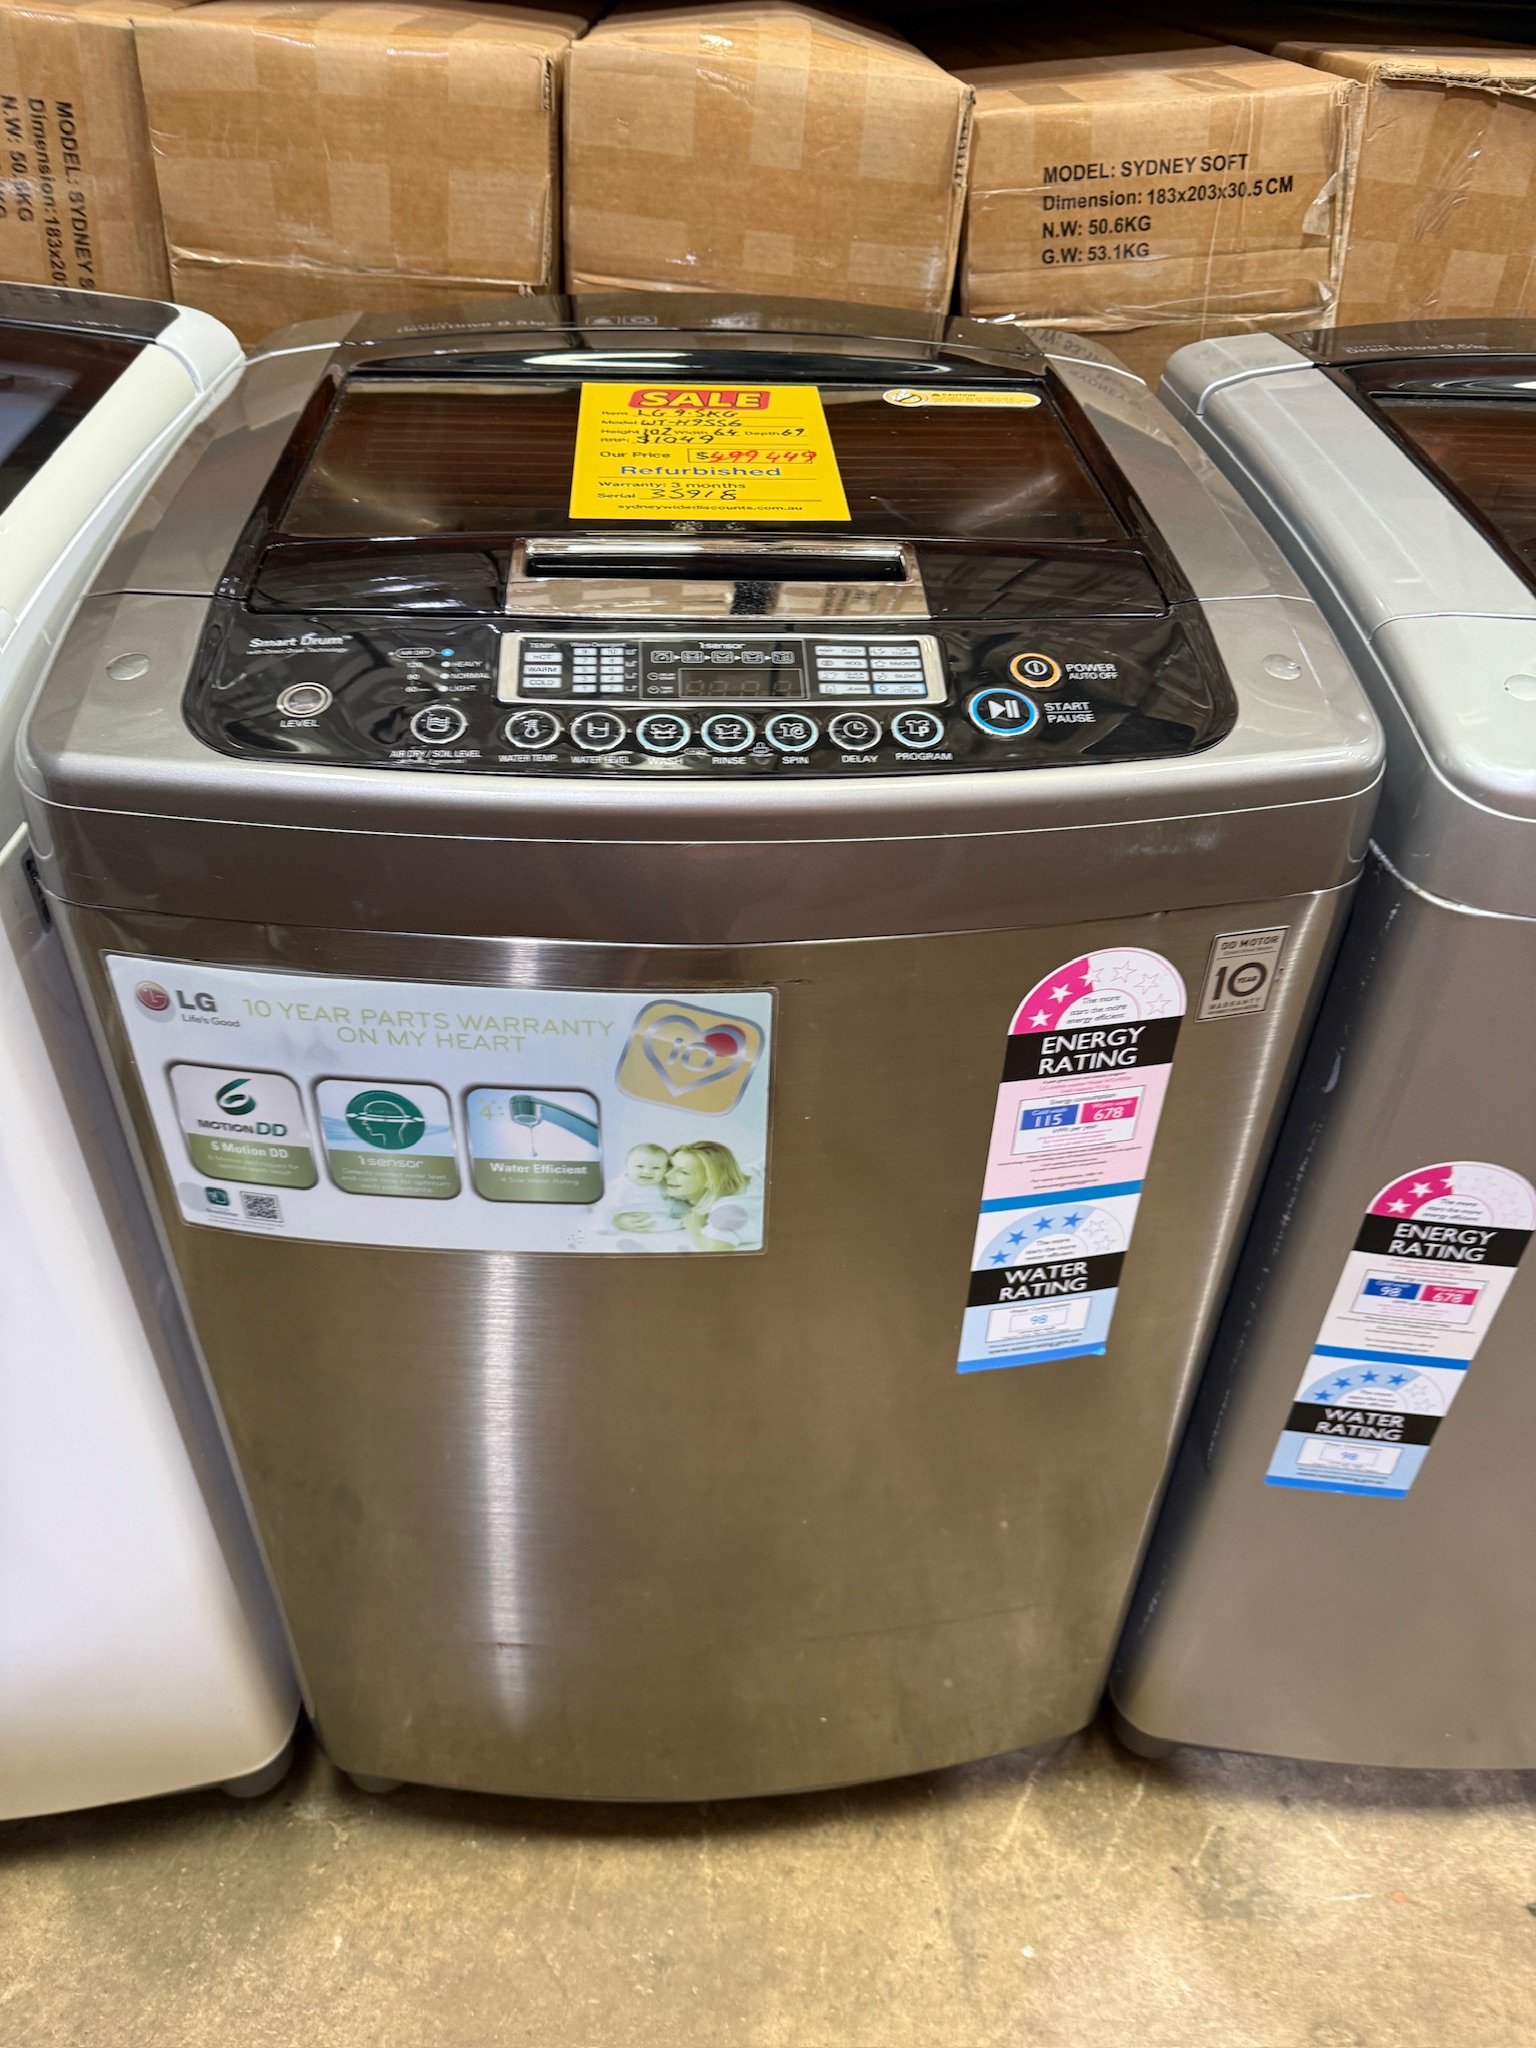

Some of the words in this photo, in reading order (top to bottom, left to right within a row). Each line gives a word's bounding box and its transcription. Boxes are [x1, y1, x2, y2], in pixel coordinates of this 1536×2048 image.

[56, 100, 81, 184] MODEL:
[28, 98, 56, 213] Dimension:
[1043, 163, 1115, 184] MODEL:
[1121, 156, 1197, 177] SYDNEY
[1200, 153, 1248, 172] SOFT
[1043, 190, 1142, 211] Dimension:
[1147, 180, 1262, 205] 183x203x30.5
[1266, 175, 1294, 195] CM
[68, 191, 94, 274] SYDNEY
[1042, 221, 1082, 239] N.W:
[1088, 215, 1151, 235] 50.6KG
[1042, 248, 1082, 264] G.W:
[1088, 242, 1149, 261] 53.1KG
[640, 391, 762, 409] SALE
[600, 450, 629, 459] Our
[632, 450, 671, 459] Price
[620, 465, 782, 477] Refurbished
[598, 481, 666, 489] Warranty:
[686, 481, 746, 490] months
[598, 492, 636, 500] Serial
[617, 503, 803, 513] sydneywidediscounts.com.au
[249, 637, 298, 648] Smart
[1065, 663, 1117, 673] POWER
[1068, 672, 1099, 680] AUTO
[1099, 671, 1119, 679] OFF
[1044, 702, 1091, 712] START
[279, 719, 320, 728] LEVEL
[1047, 713, 1096, 723] PAUSE
[389, 749, 406, 758] AIR
[454, 749, 483, 758] LEVEL
[498, 755, 531, 763] WATER
[570, 756, 602, 764] WATER
[603, 756, 631, 764] LEVEL
[648, 757, 684, 766] WASH
[711, 756, 747, 765] RINSE
[782, 756, 810, 765] SPIN
[841, 755, 879, 764] DELAY
[895, 753, 953, 761] PROGRAM
[1239, 936, 1279, 948] MOTOR
[1212, 962, 1268, 1001] 10
[176, 990, 218, 1013] LG
[1104, 1004, 1127, 1012] more
[182, 1013, 210, 1025] Life's
[211, 1017, 241, 1028] Good
[242, 998, 272, 1018] 10
[278, 1002, 351, 1024] YEAR
[361, 1008, 450, 1030] PARTS
[456, 1014, 614, 1037] WARRANTY
[337, 1026, 378, 1045] ON
[387, 1029, 425, 1047] MY
[436, 1032, 526, 1053] HEART
[1041, 1026, 1147, 1056] ENERGY
[1038, 1048, 1138, 1076] RATING
[1034, 1114, 1063, 1128] 115
[1093, 1106, 1125, 1121] 678
[197, 1119, 255, 1134] MOTION
[256, 1121, 289, 1137] DD
[211, 1140, 220, 1151] 6
[221, 1141, 267, 1157] Motion
[269, 1147, 289, 1159] DD
[489, 1162, 530, 1174] Water
[533, 1163, 588, 1175] Efficient
[1393, 1222, 1499, 1246] ENERGY
[1387, 1239, 1487, 1262] RATING
[1004, 1261, 1089, 1284] WATER
[999, 1276, 1089, 1301] RATING
[1380, 1286, 1403, 1298] 98
[1432, 1292, 1466, 1304] 678
[1324, 1407, 1406, 1429] WATER
[1314, 1420, 1404, 1441] RATING
